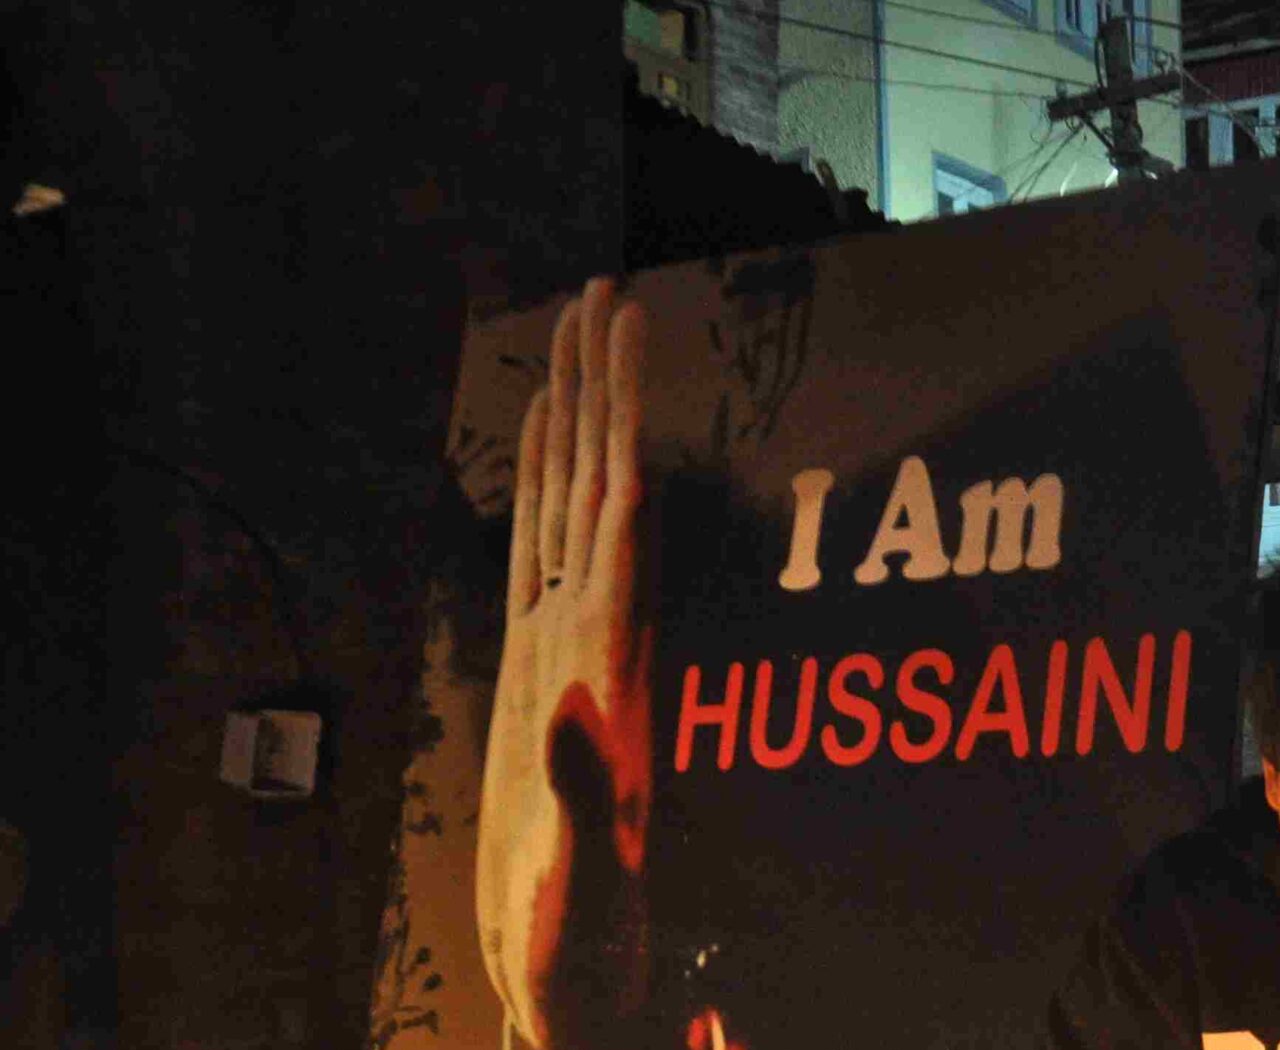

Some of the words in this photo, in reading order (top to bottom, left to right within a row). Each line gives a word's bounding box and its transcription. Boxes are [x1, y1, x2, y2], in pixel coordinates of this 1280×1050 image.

[778, 467, 835, 592] I
[853, 455, 1065, 586] Am
[674, 629, 1192, 773] HUSSAINI
